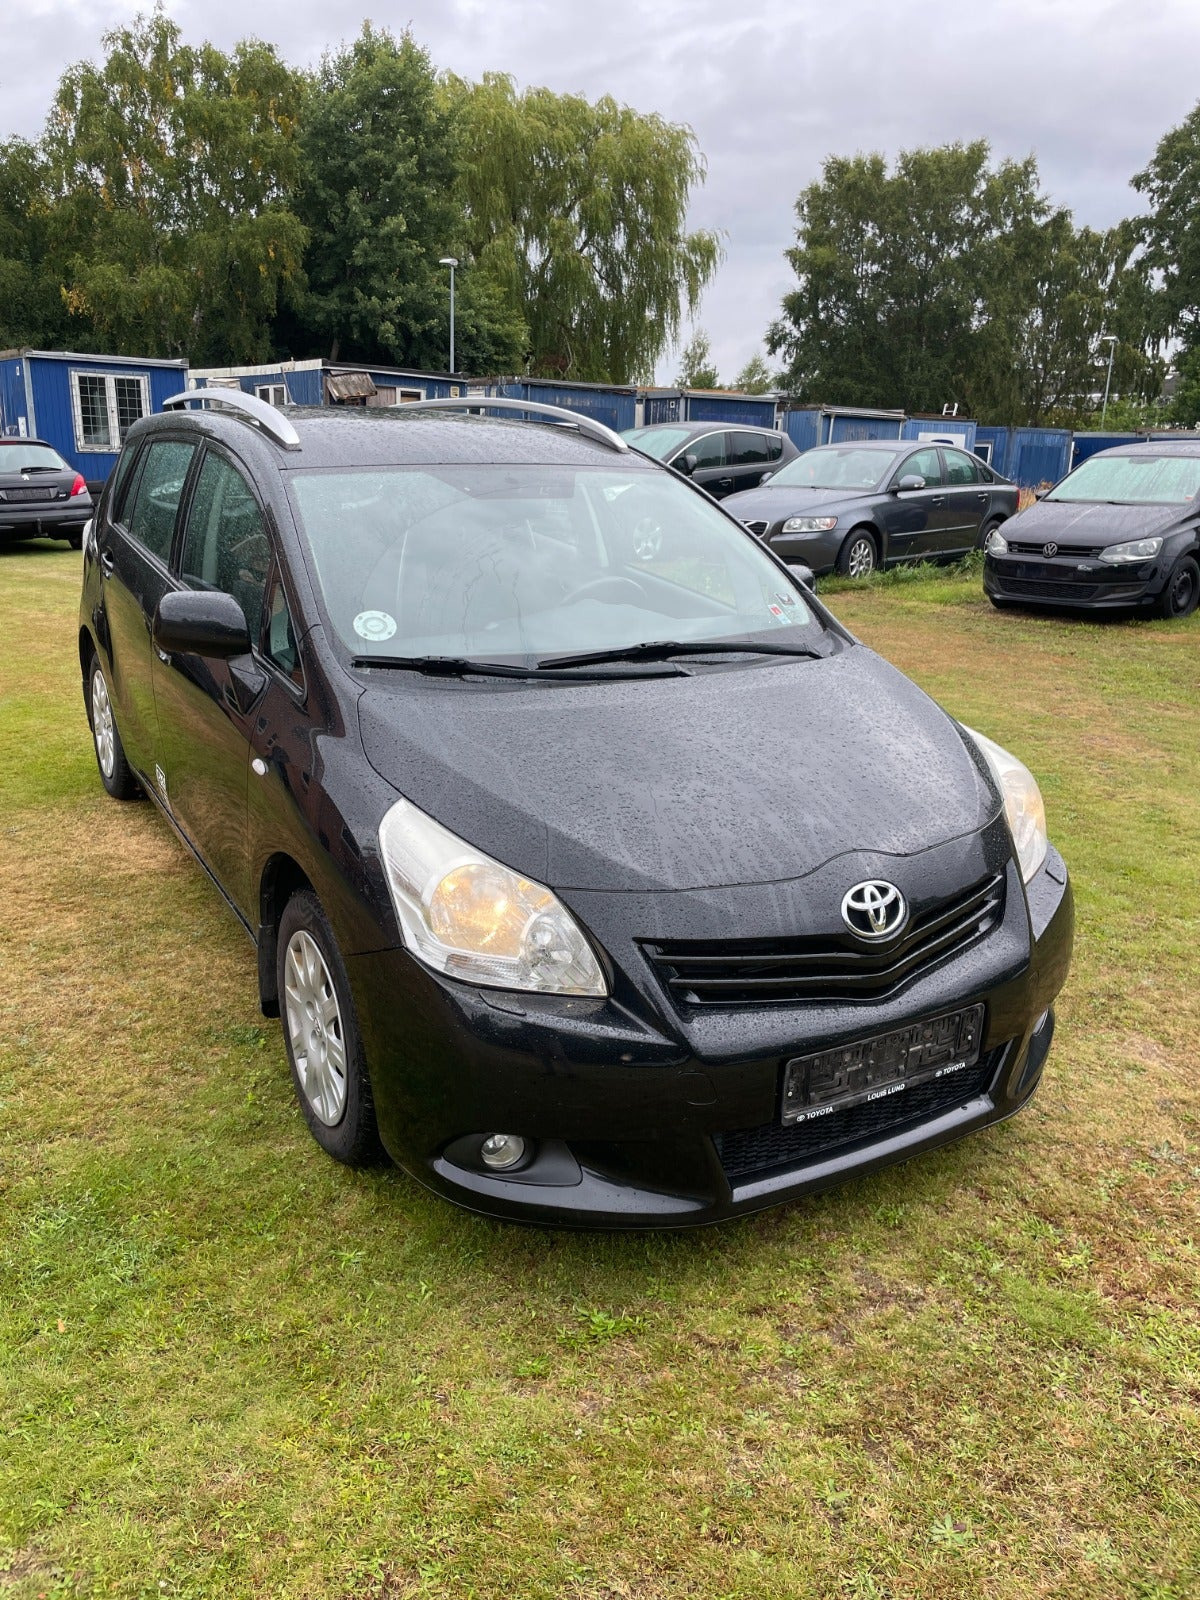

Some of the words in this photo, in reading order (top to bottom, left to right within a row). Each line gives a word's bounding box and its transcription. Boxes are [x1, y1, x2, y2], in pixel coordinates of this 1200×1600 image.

[943, 1062, 966, 1075] TOYOTA
[867, 1090, 887, 1101] LOUIS
[887, 1083, 906, 1095] LUND
[806, 1106, 833, 1119] TOYOTA
